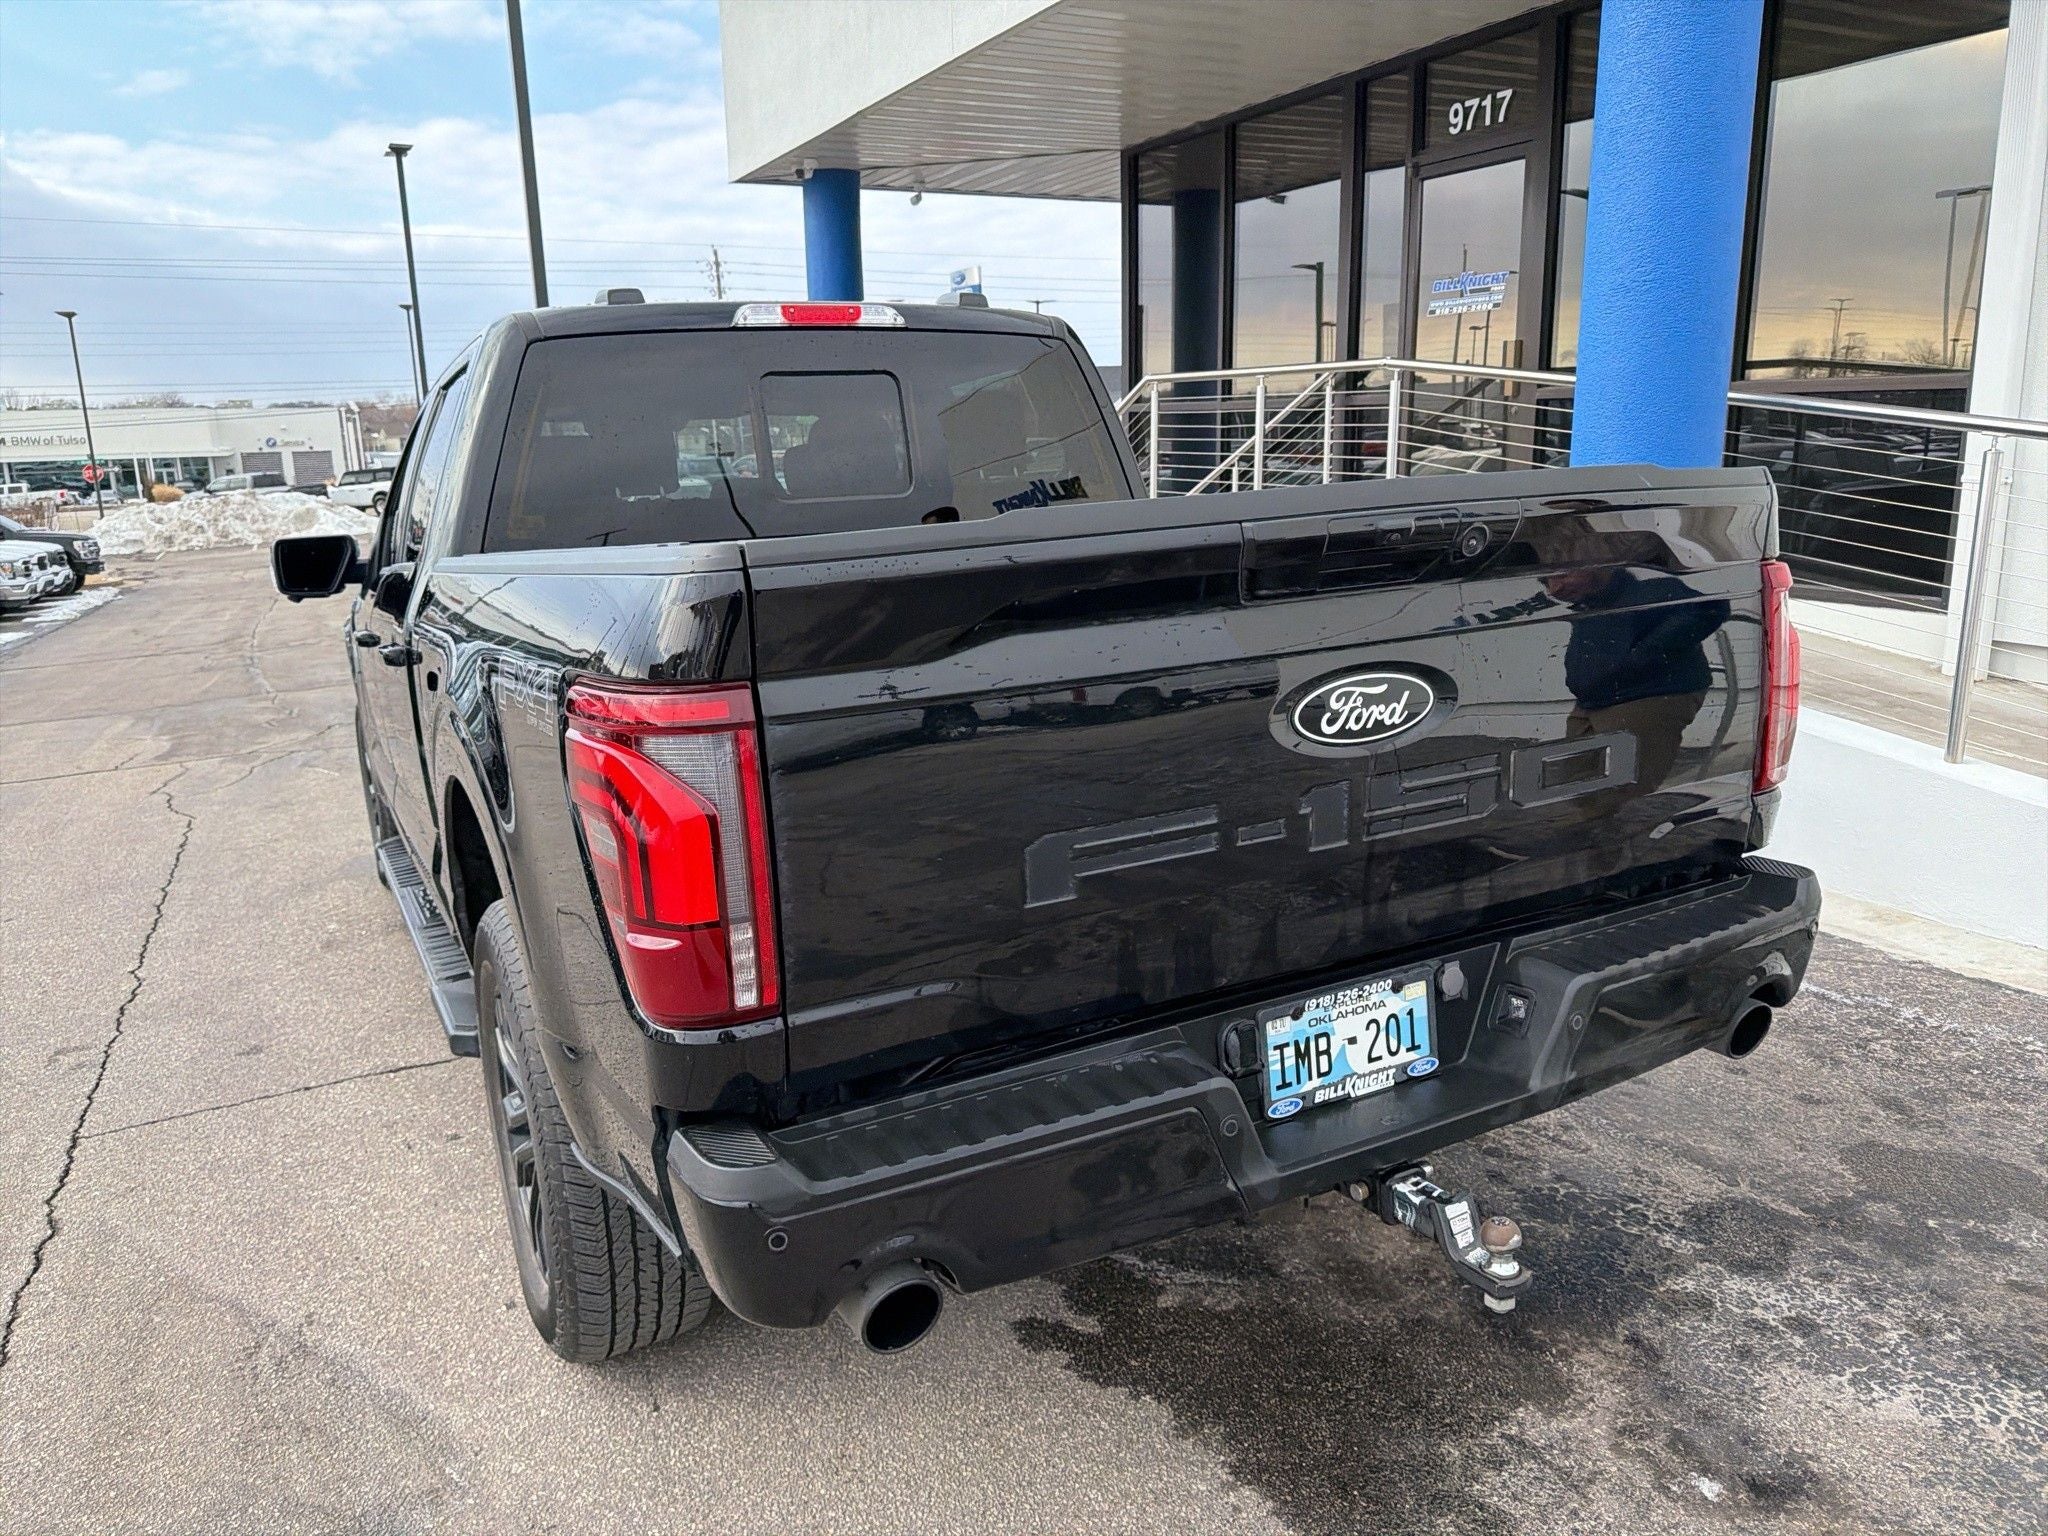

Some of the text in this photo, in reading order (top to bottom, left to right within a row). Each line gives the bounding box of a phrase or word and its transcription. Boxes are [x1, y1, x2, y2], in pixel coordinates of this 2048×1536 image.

[1448, 88, 1513, 135] 9717
[11, 435, 87, 446] BMW of Tulsa
[1319, 682, 1409, 735] Ford
[1024, 730, 1638, 909] F-150
[1304, 993, 1336, 1012] (918)
[1336, 979, 1393, 1004] 526-2400
[1308, 1000, 1387, 1028] OKLAHOMA
[1273, 1007, 1421, 1092] IMB 201
